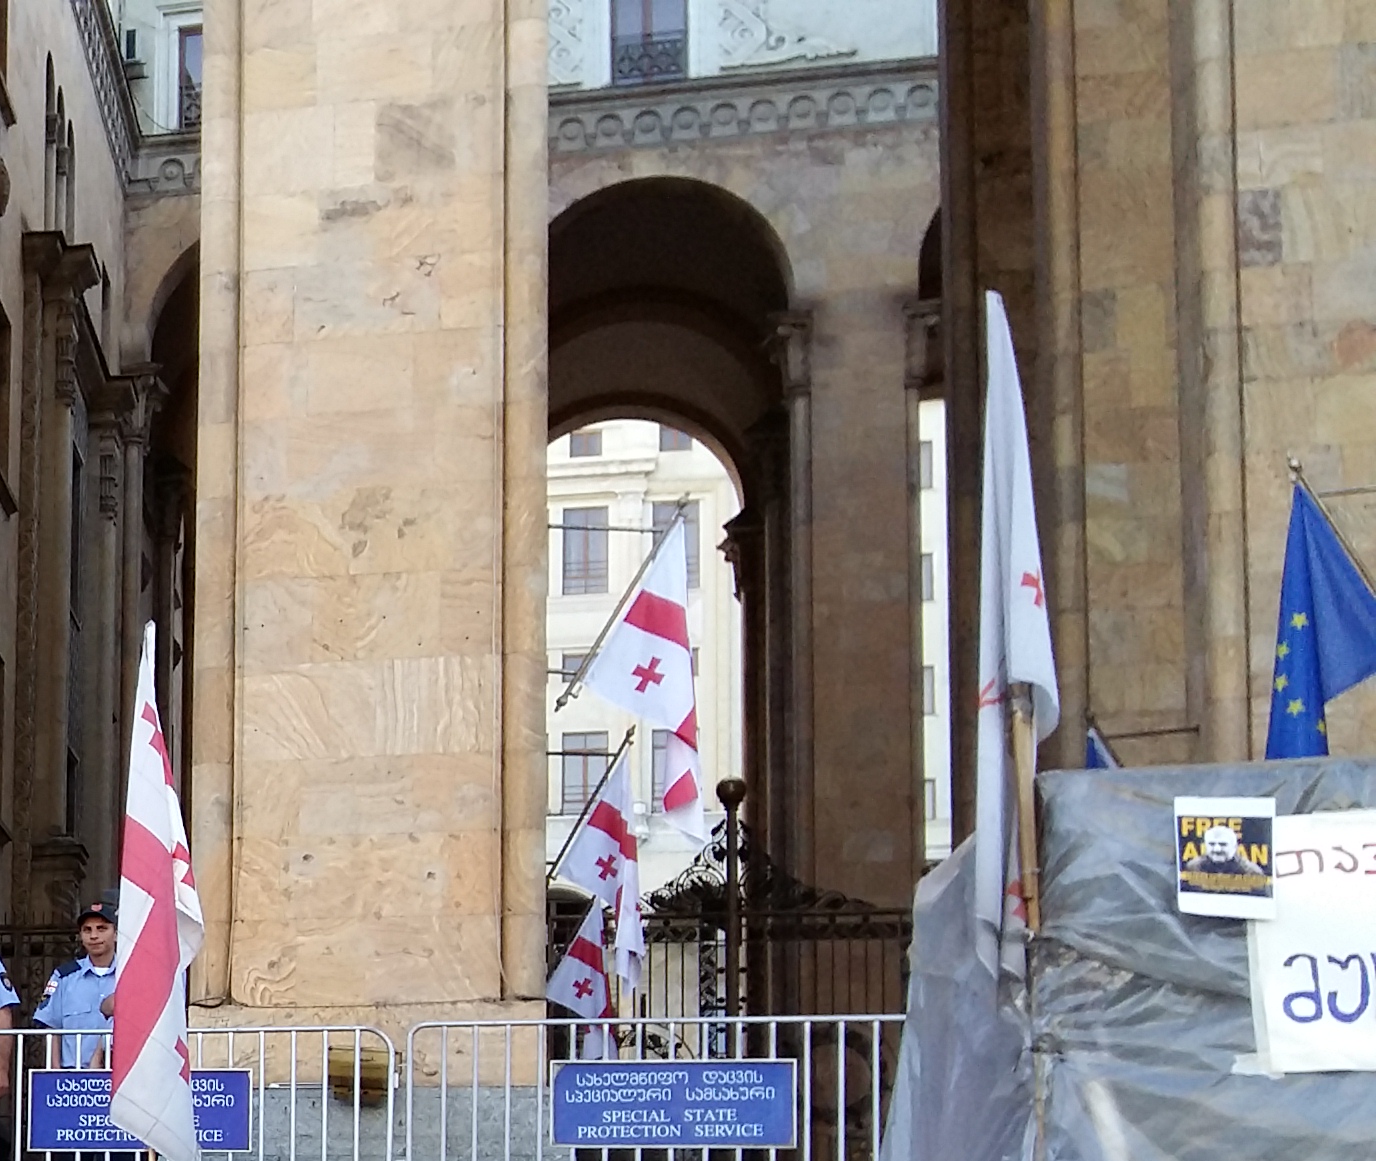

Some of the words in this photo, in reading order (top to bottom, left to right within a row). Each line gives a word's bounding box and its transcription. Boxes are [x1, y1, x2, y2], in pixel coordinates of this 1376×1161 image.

[1183, 843, 1268, 865] AAN
[1283, 953, 1376, 1023] მუ
[576, 1071, 688, 1086] სახელმწიფო
[703, 1070, 763, 1085] დაცვის
[47, 1095, 111, 1107] სპეციალ
[566, 1087, 671, 1103] სპეციალური
[686, 1087, 775, 1101] სამსახური
[79, 1115, 111, 1127] SPEC
[602, 1109, 670, 1123] SPECIAL
[684, 1109, 737, 1121] STATE
[56, 1129, 138, 1141] PROTECTIO
[195, 1130, 223, 1141] VICE
[578, 1125, 681, 1139] PROTECTION
[695, 1124, 764, 1137] SERVICE
